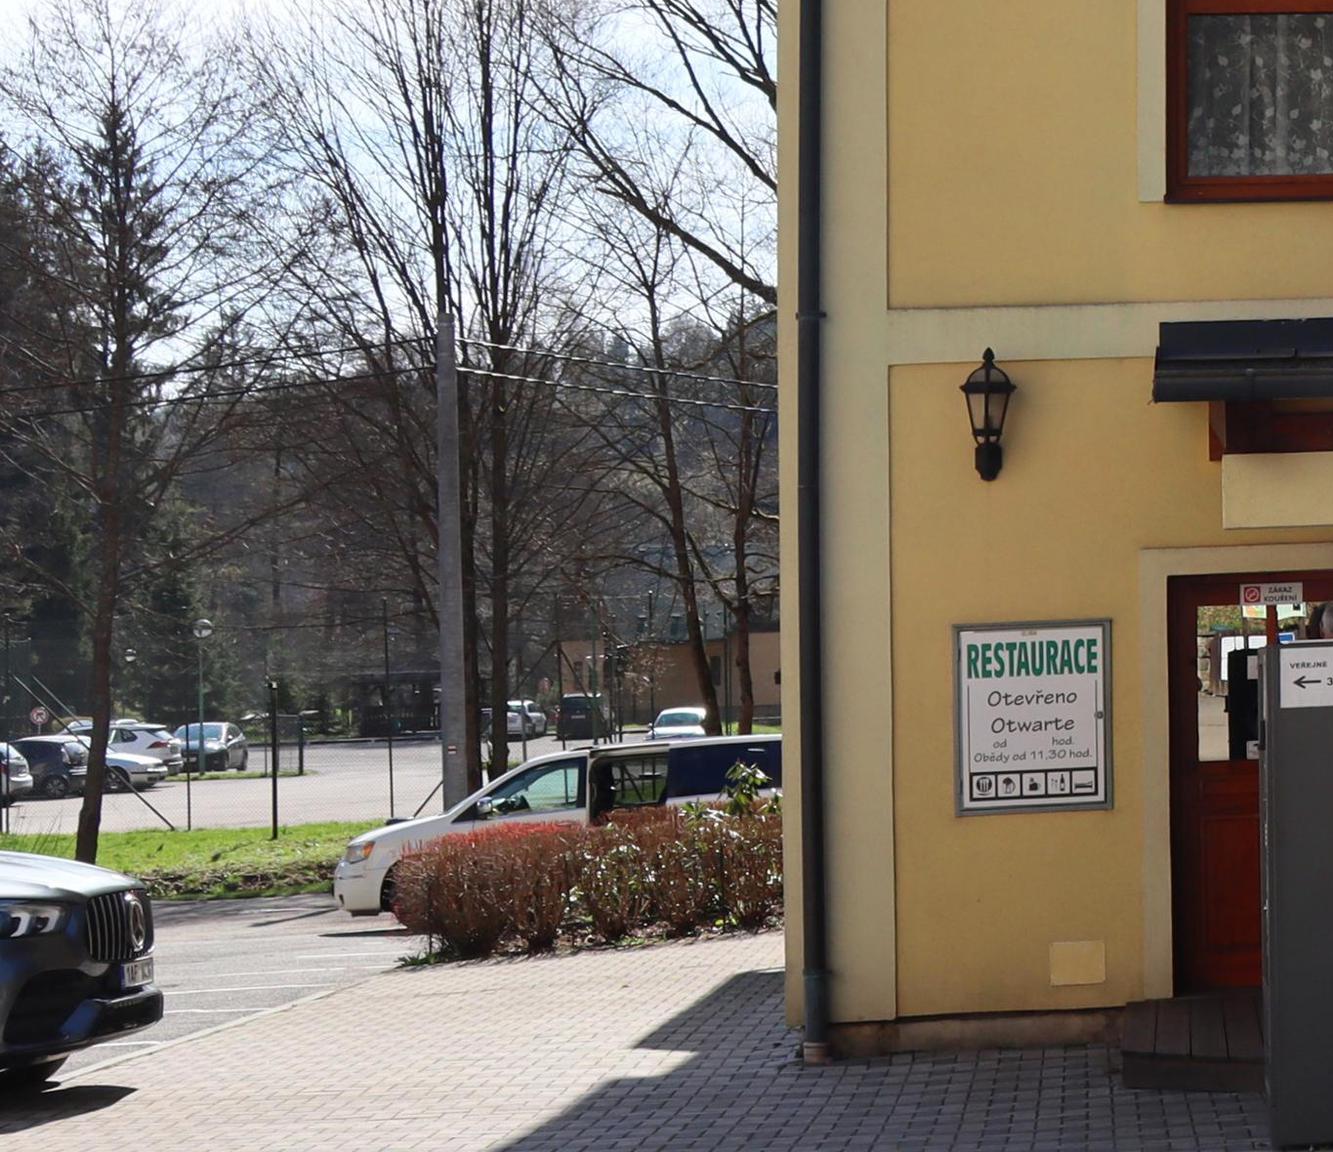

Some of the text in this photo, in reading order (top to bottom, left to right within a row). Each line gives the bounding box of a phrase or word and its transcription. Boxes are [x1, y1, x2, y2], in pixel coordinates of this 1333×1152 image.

[967, 638, 1098, 679] RESTAURACE
[987, 690, 1078, 707] Otevřeno
[991, 717, 1075, 734] Otwarte
[993, 739, 1008, 749] od
[1012, 751, 1027, 762] od
[1069, 748, 1093, 759] hod.
